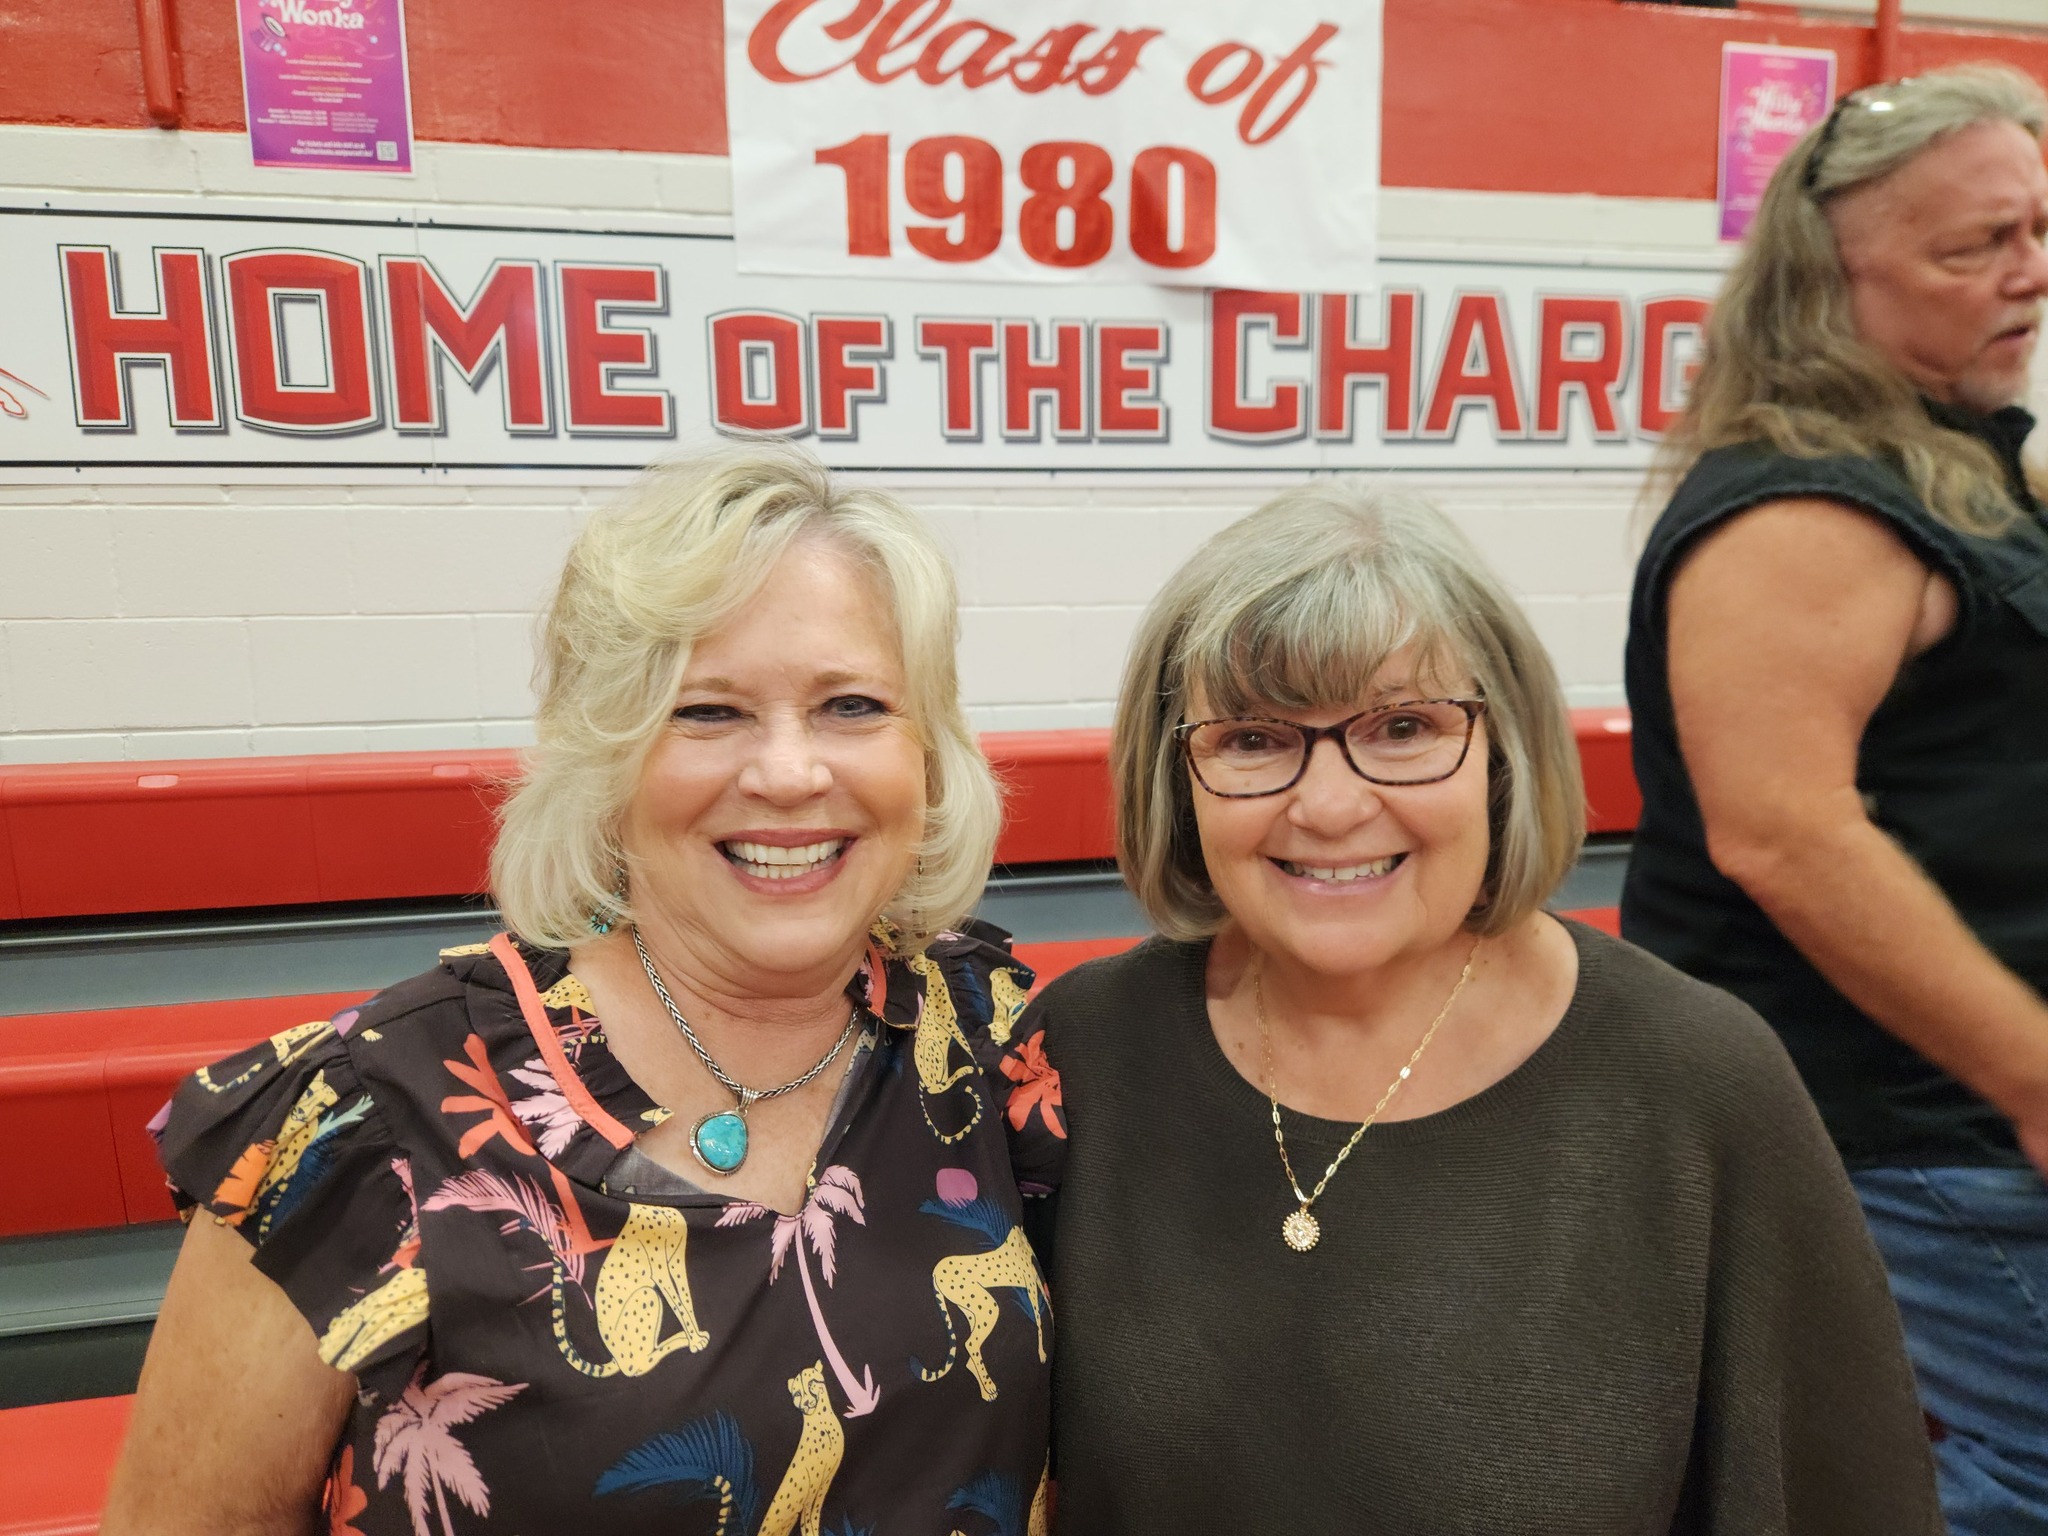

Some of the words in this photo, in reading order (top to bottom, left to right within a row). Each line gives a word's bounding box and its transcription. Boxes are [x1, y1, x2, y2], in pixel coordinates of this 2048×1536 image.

[270, 0, 365, 29] Wonka
[747, 0, 1163, 96] Class
[1186, 21, 1339, 147] of
[814, 132, 1217, 270] 1980
[57, 243, 675, 438] HOME
[706, 308, 894, 442] OF
[914, 314, 1170, 443] THE
